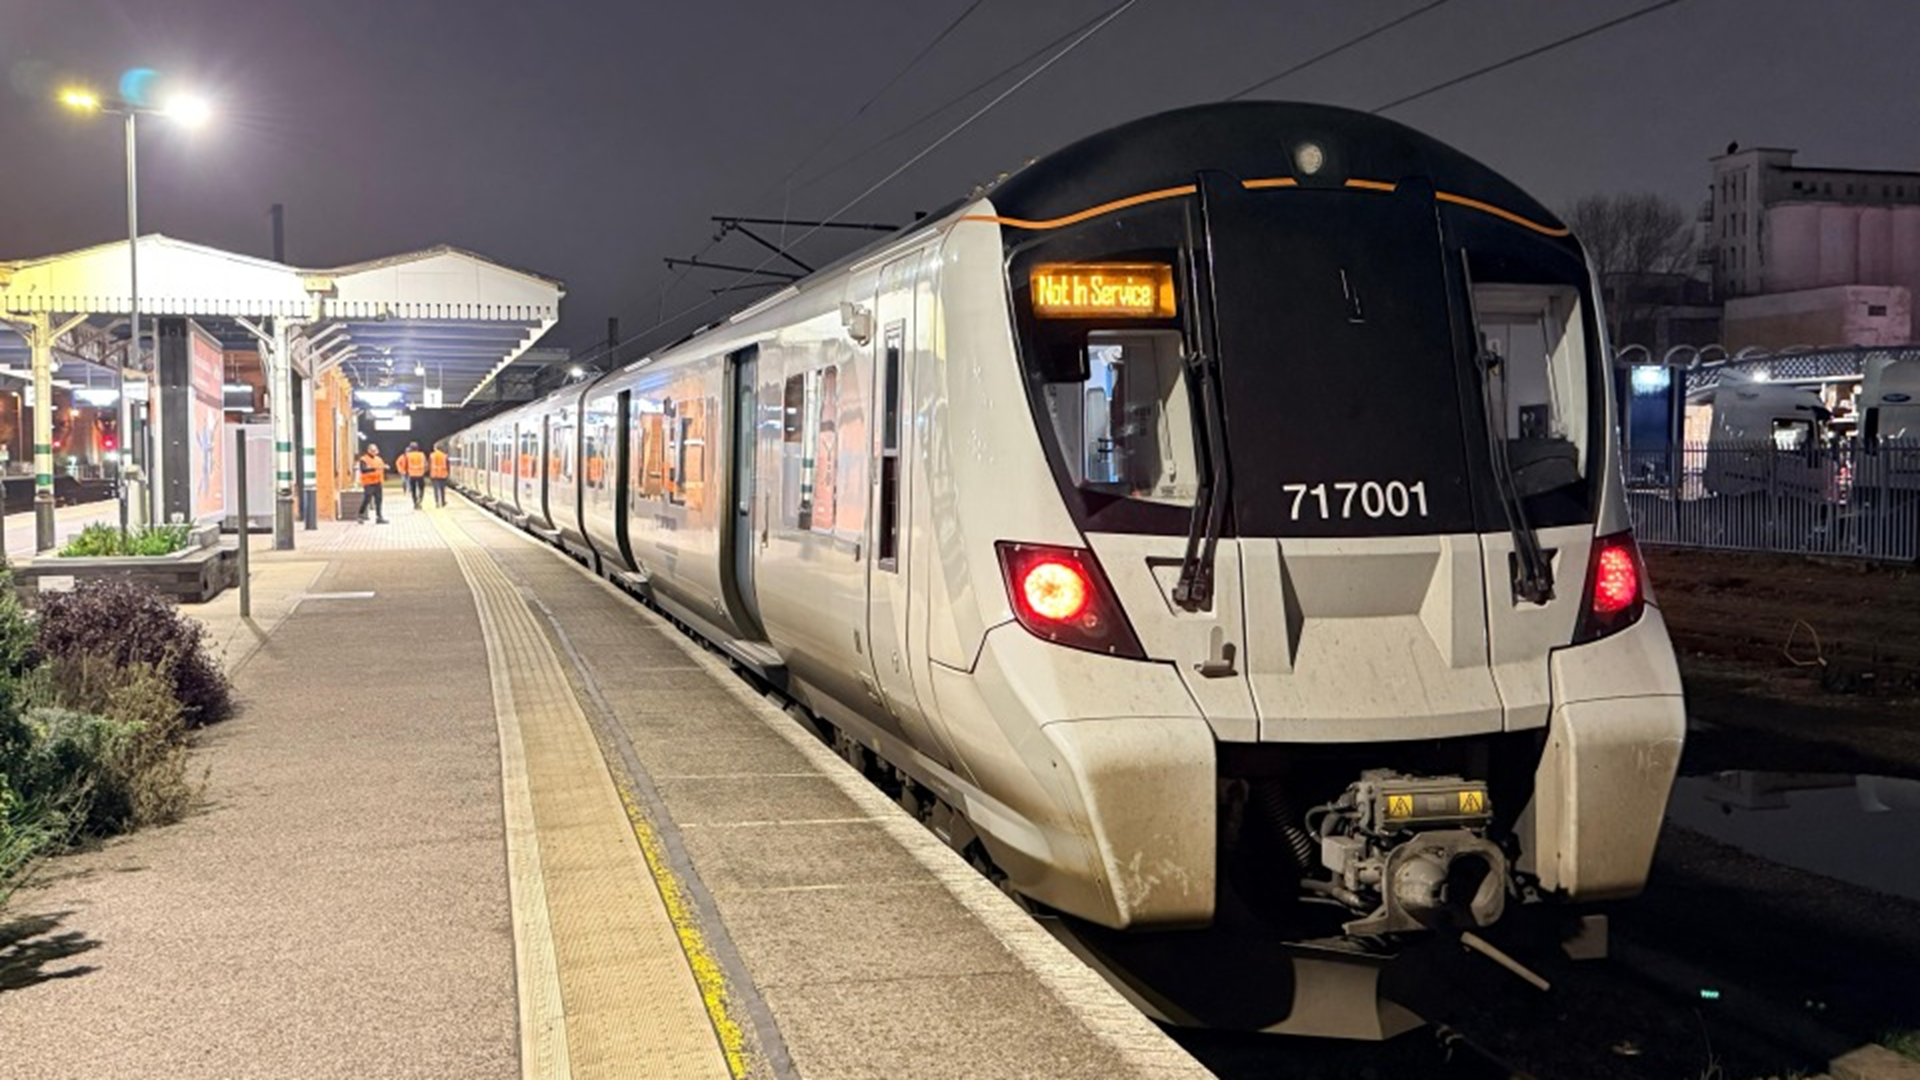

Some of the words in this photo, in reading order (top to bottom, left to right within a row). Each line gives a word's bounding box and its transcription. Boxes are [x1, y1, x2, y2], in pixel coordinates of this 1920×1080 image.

[1038, 275, 1069, 306] Not
[1073, 275, 1088, 306] In
[1090, 275, 1152, 306] Service
[1282, 480, 1429, 521] 717001
